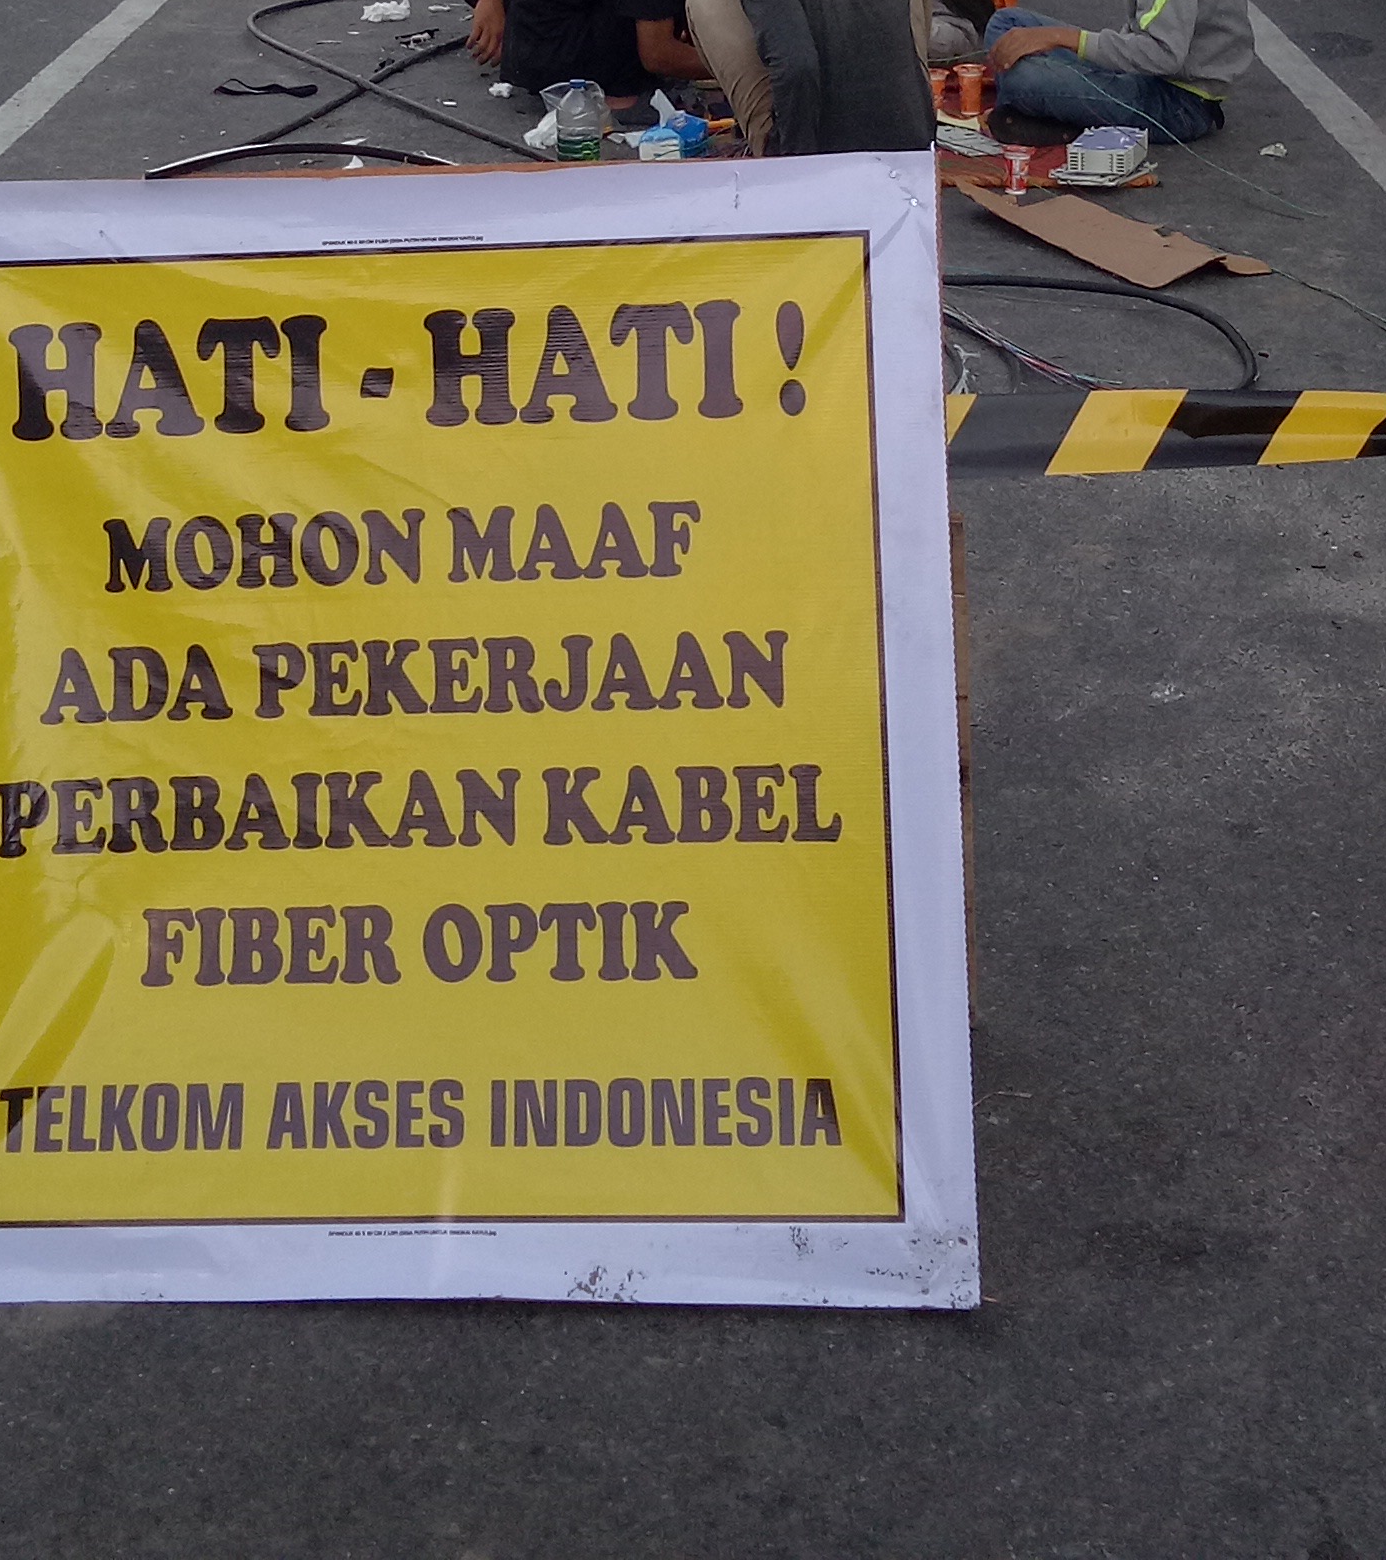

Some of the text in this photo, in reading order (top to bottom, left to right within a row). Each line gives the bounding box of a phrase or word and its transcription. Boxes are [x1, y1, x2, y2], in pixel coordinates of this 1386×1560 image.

[8, 314, 331, 442] HATI
[102, 500, 701, 594] MOHON MAAF
[39, 630, 789, 726] ADA PEKERJAAN
[541, 763, 843, 846] KABEL
[140, 900, 699, 988] FIBER OPTIK
[266, 1079, 465, 1149] AKSES
[490, 1076, 843, 1148] INDONESIA
